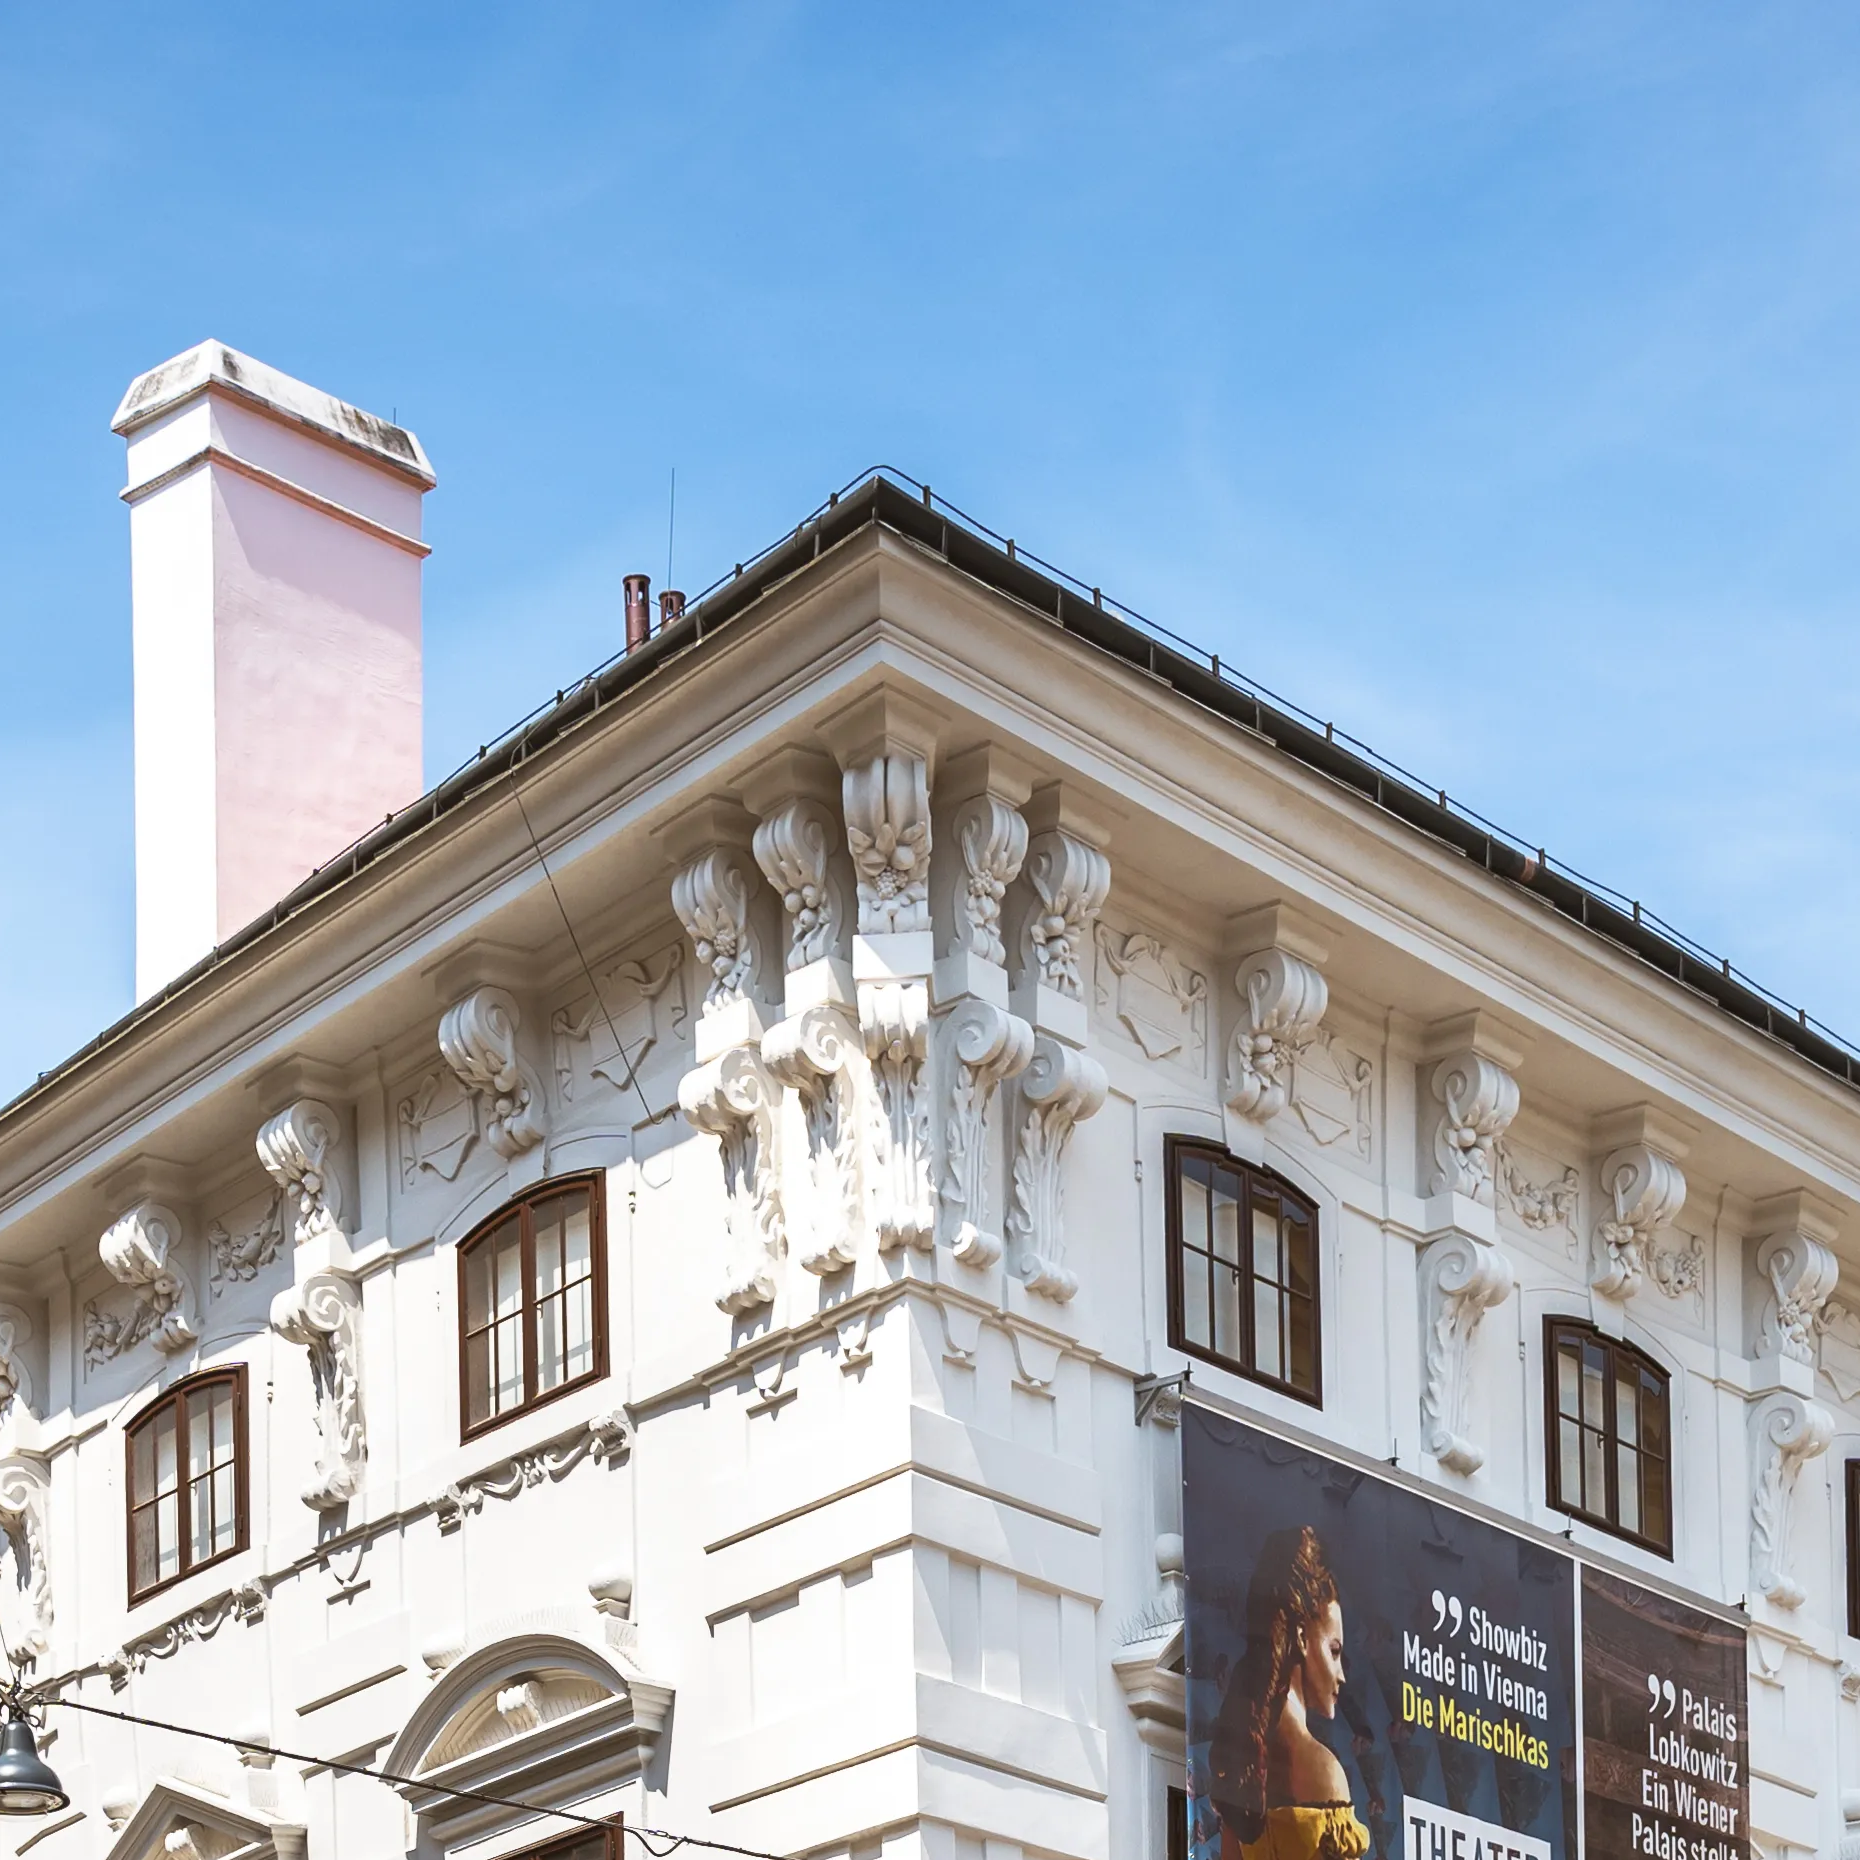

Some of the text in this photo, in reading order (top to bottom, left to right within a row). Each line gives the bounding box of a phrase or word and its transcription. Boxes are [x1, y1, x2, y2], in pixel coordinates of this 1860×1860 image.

[1469, 1606, 1547, 1672] Showbiz
[1403, 1630, 1548, 1721] Made in Vienna
[1402, 1681, 1549, 1770] Die Marischkas
[1682, 1688, 1738, 1742] Palais
[1649, 1722, 1738, 1789] Lobkowitz
[1641, 1768, 1739, 1836] Ein Wiener
